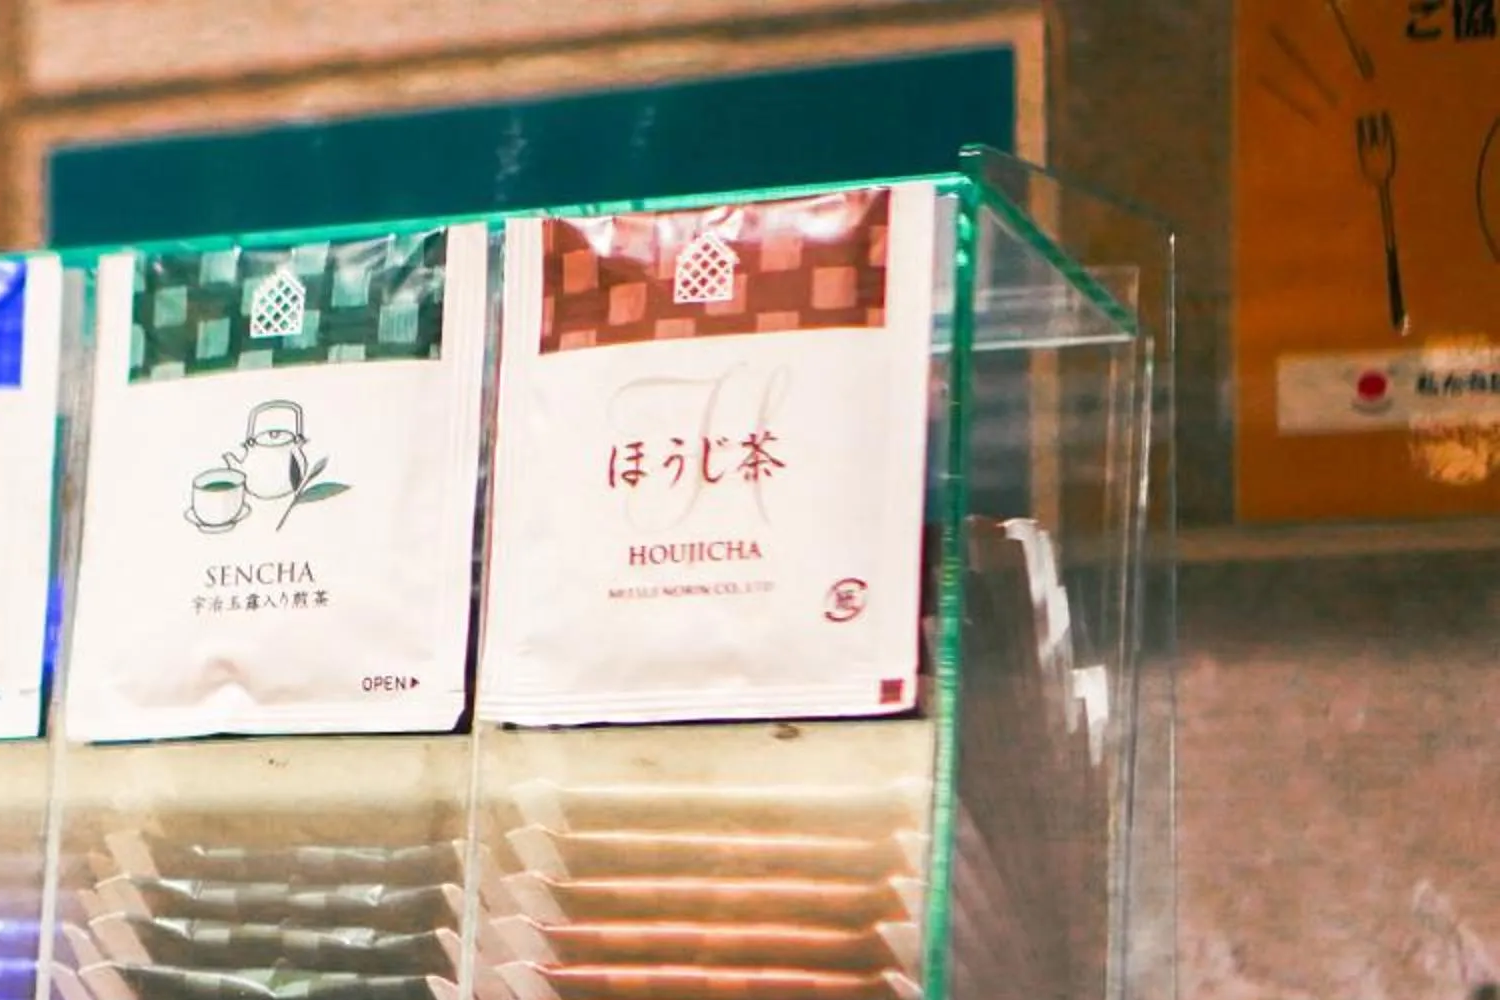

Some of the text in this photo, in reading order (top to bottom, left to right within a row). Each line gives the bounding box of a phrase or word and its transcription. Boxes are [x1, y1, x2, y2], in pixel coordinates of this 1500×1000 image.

[607, 430, 787, 489] ほうじ茶
[628, 539, 763, 567] HOUJICHA
[204, 560, 315, 588] SENCHA
[361, 675, 407, 692] OPEN
